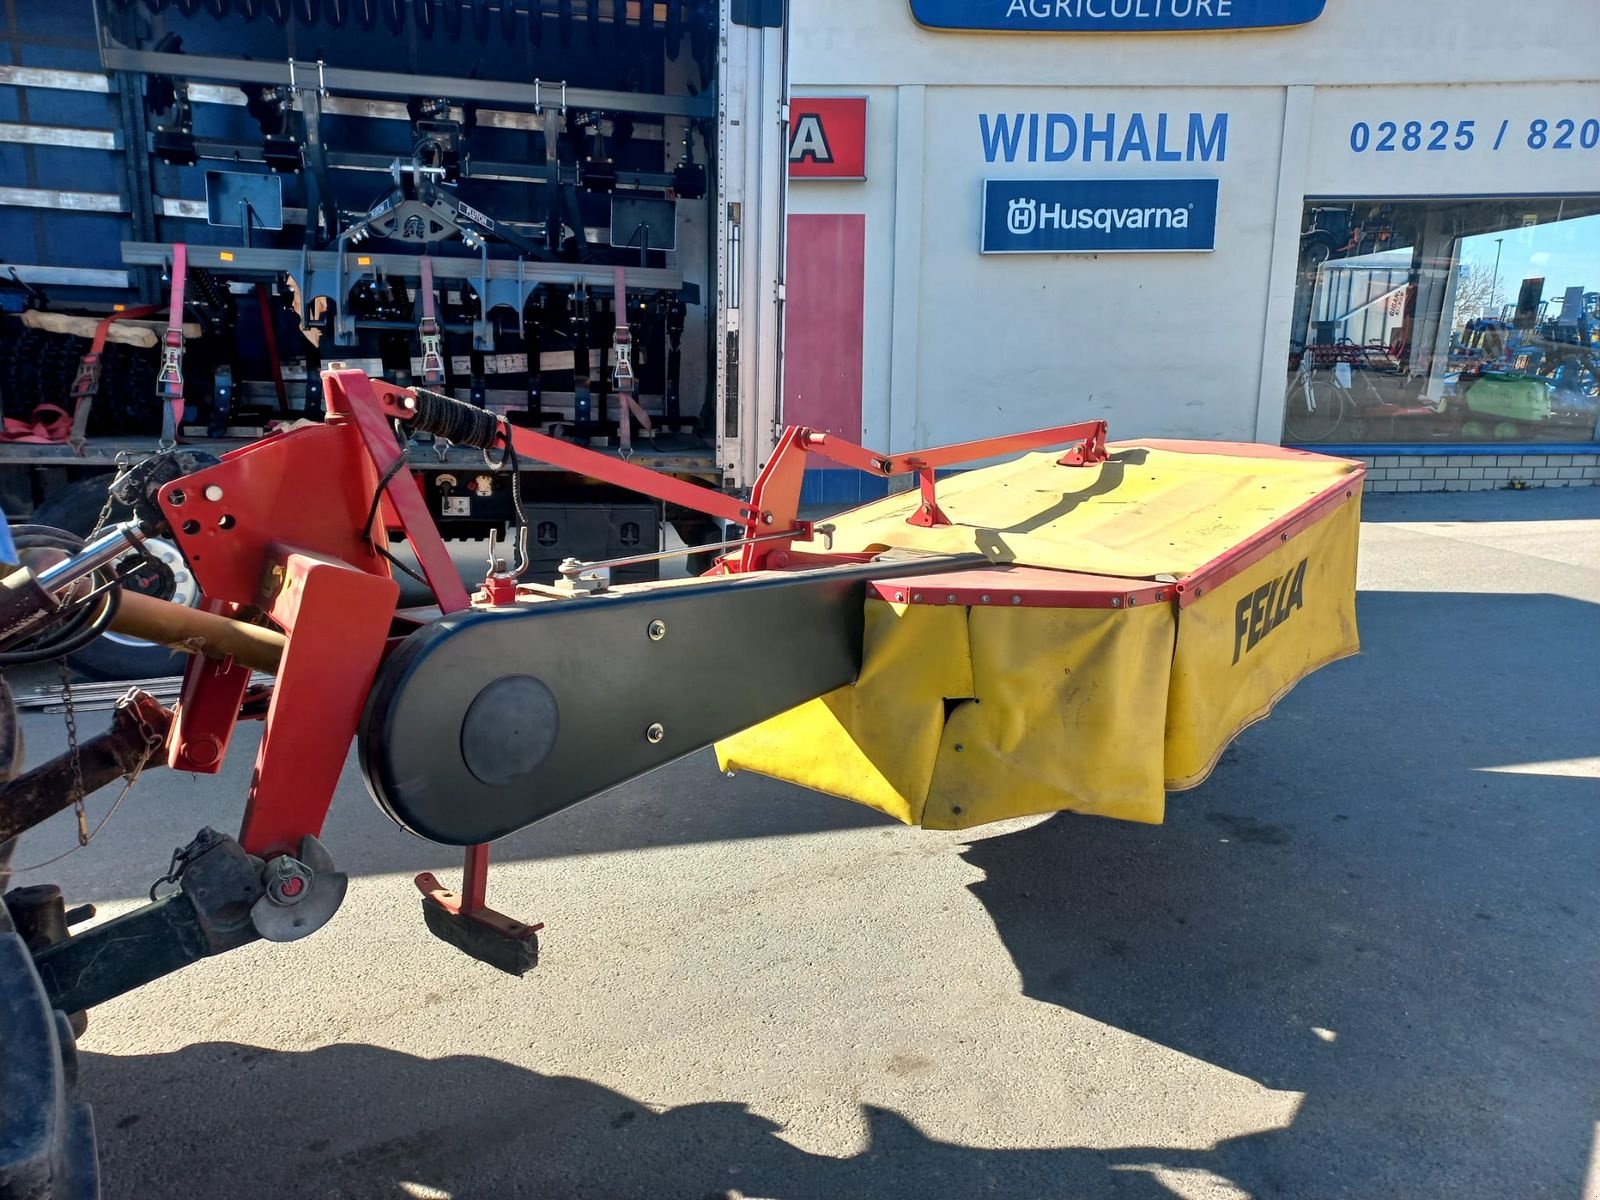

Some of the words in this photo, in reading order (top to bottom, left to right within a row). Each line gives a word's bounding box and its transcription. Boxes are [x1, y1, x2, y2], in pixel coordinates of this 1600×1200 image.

[978, 112, 1229, 163] WIDHALM
[1350, 120, 1475, 153] 02825
[1493, 119, 1509, 151] /
[1526, 118, 1600, 150] 820
[1039, 202, 1189, 233] Husqvarna
[1231, 556, 1309, 668] FELLA
